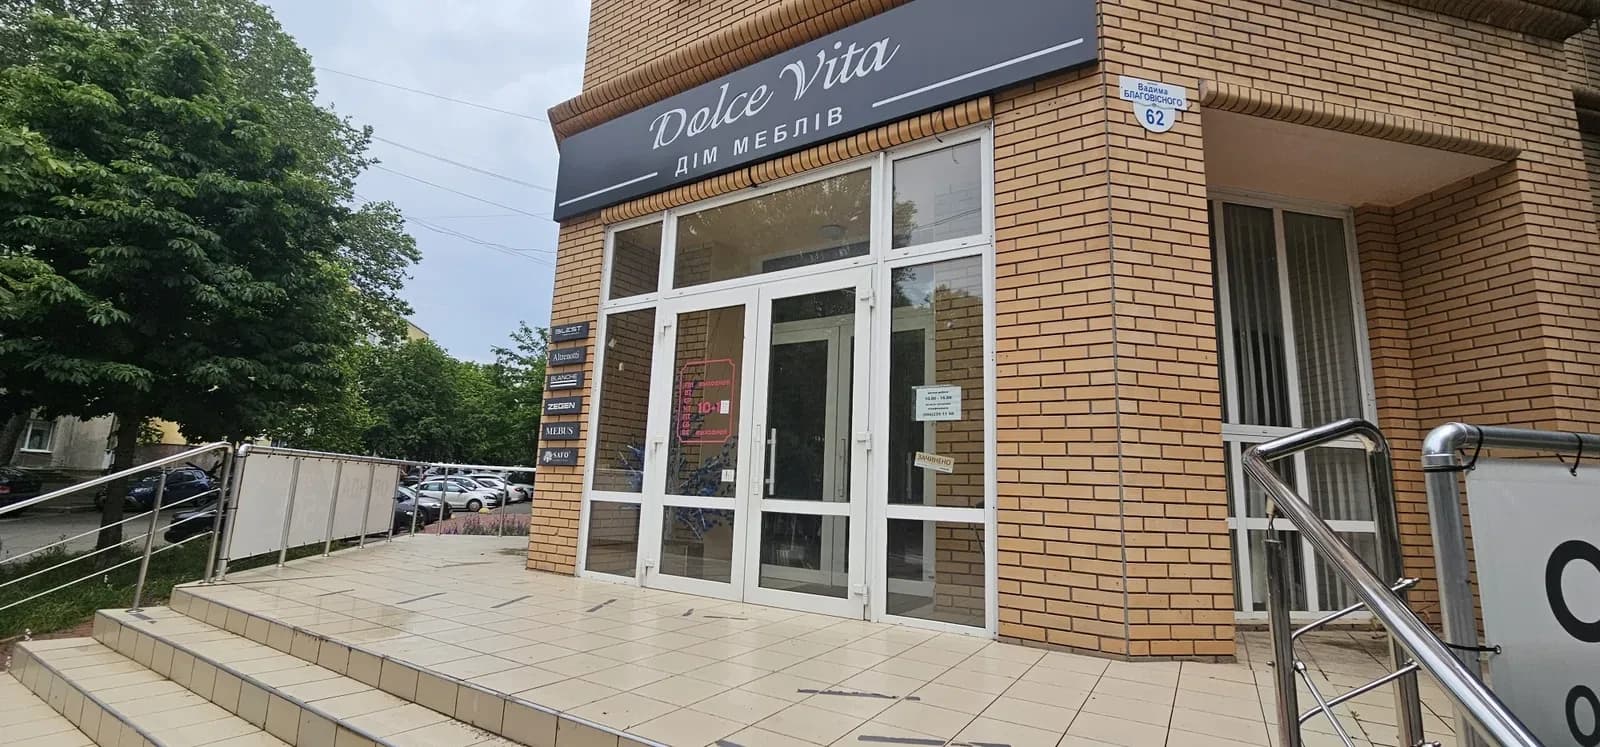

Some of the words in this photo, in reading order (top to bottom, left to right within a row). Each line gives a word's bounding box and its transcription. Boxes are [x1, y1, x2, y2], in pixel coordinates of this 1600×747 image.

[649, 83, 773, 150] Dolce
[778, 37, 900, 101] Vita
[1137, 83, 1168, 95] Вадима
[1124, 90, 1183, 107] БЛАГОВІСНОГО
[1146, 109, 1164, 126] 62
[674, 146, 718, 177] ДІМ
[733, 106, 843, 156] МЕБЛІВ
[551, 373, 577, 381] BLANCHE
[547, 402, 576, 411] ZEGEN
[545, 427, 574, 436] MEBUS
